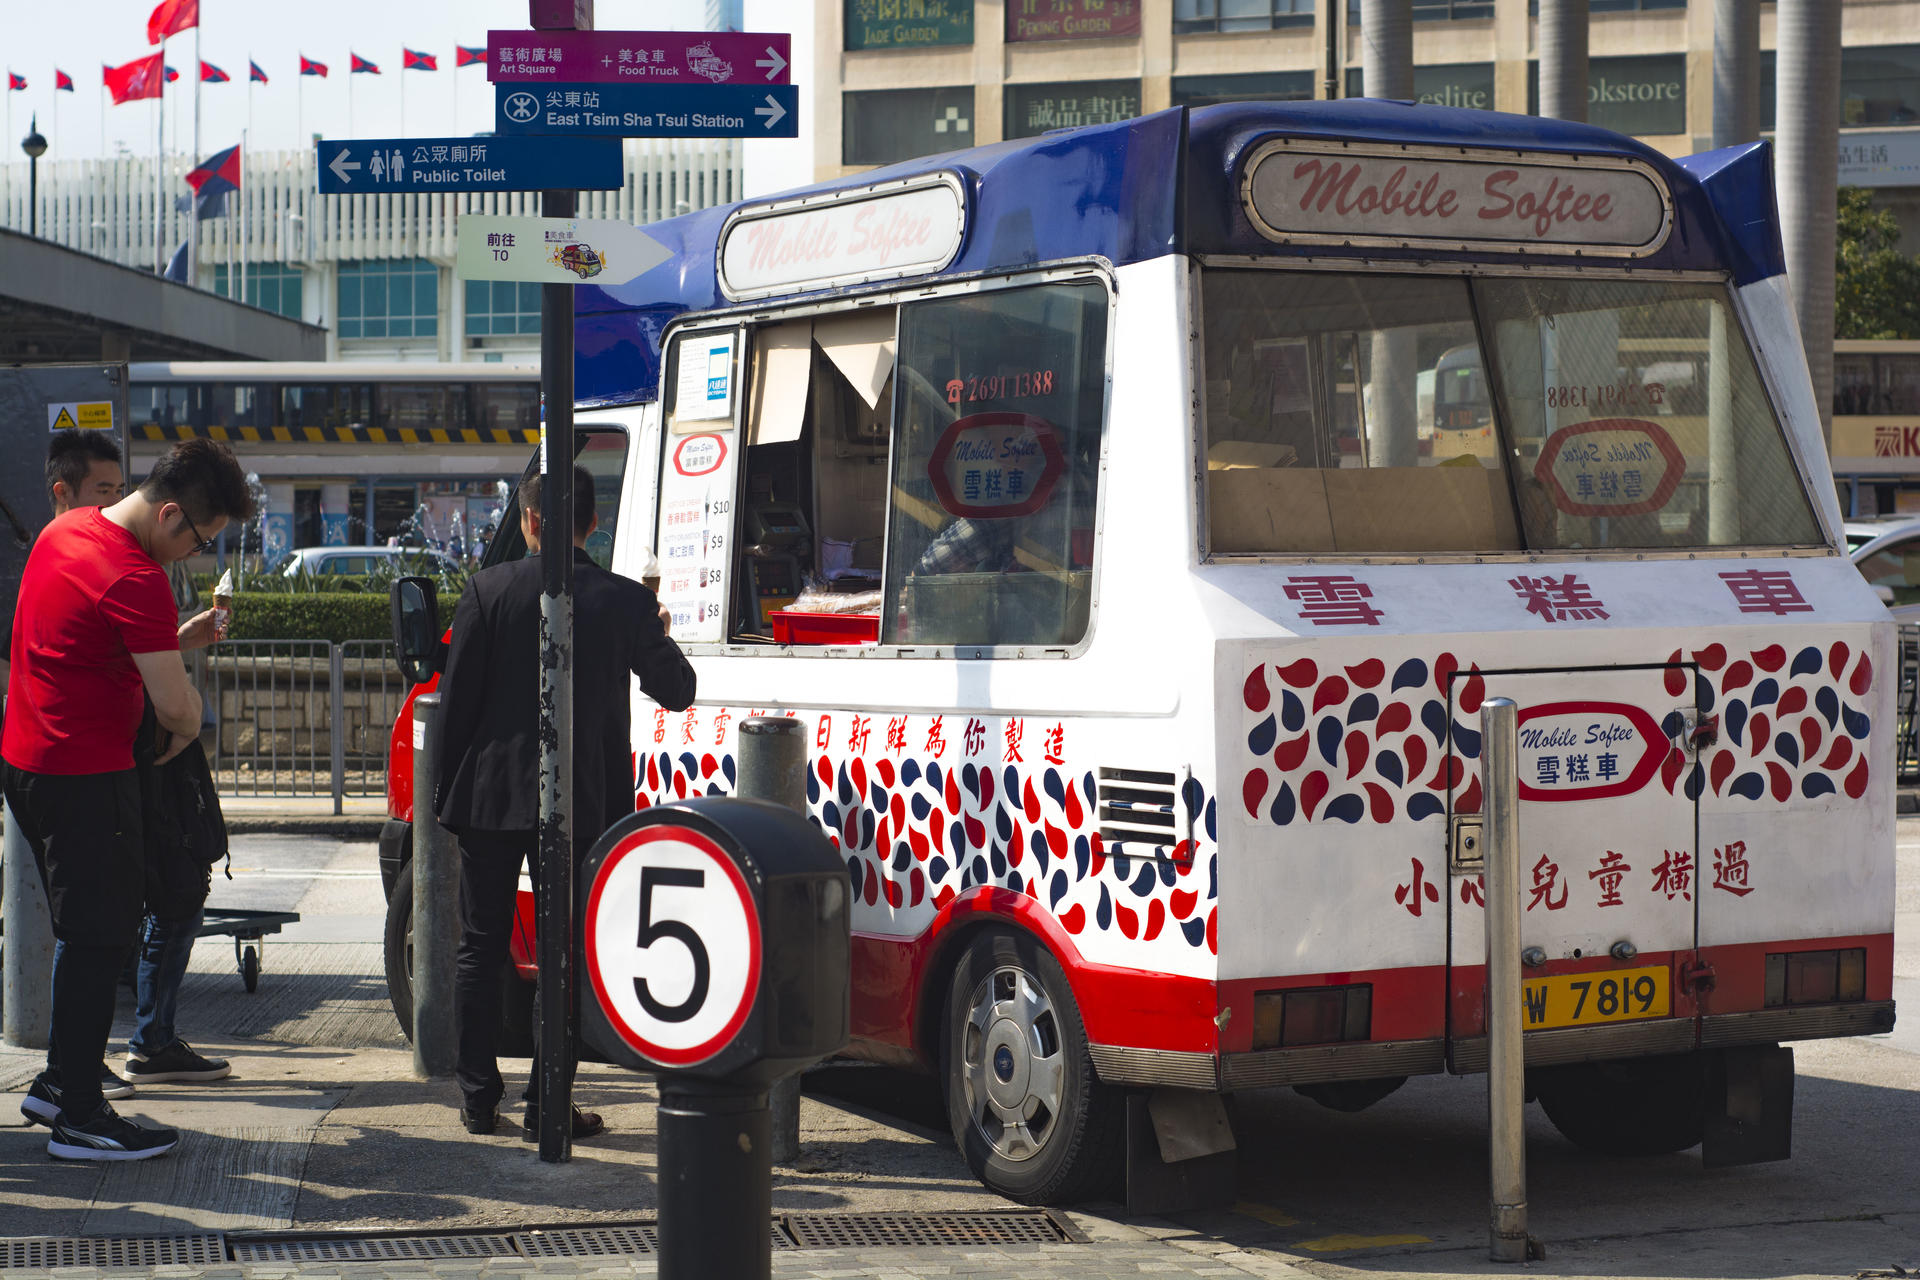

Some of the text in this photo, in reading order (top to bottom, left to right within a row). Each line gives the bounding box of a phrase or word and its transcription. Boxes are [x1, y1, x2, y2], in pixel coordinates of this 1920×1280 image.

[499, 47, 563, 63] 藝術廣場
[617, 48, 666, 64] 美食車
[499, 64, 556, 75] Art Square
[618, 65, 679, 76] Food Truck
[546, 91, 600, 108] 尖東站
[1419, 84, 1487, 109] eslite
[1588, 78, 1681, 103] okstore
[546, 112, 744, 128] East Tsim Sha Tsui Station
[1028, 96, 1137, 128] 誠品書店
[411, 145, 488, 163] 公眾廁所
[412, 167, 507, 184] Public Toilet
[1293, 158, 1614, 238] Mobile Softee
[486, 231, 516, 248] 前往
[748, 204, 932, 270] Mobile Softee
[492, 249, 509, 262] TO
[968, 369, 1054, 402] 2691 1388
[955, 437, 1039, 463] Mobile Softee
[964, 468, 1025, 500] 雪糕車
[713, 500, 730, 516] $10
[711, 535, 723, 551] $9
[709, 569, 721, 584] $8
[1282, 568, 1816, 627] 雪糕車
[707, 603, 719, 618] $8
[1520, 722, 1633, 749] Mobile Softee
[1536, 752, 1620, 784] 雪糕車
[632, 865, 711, 1024] 5
[1570, 975, 1656, 1019] 7819
